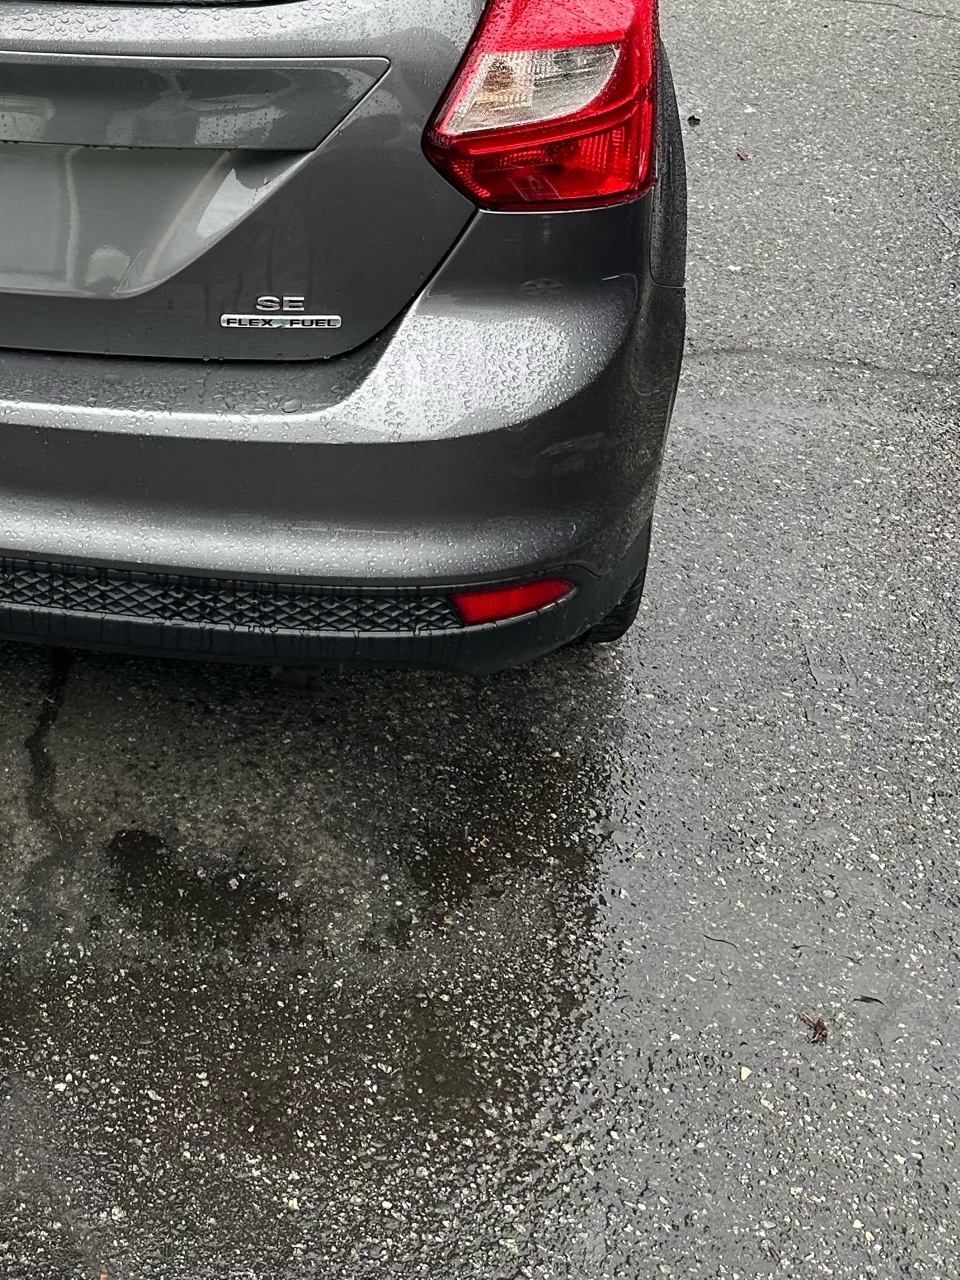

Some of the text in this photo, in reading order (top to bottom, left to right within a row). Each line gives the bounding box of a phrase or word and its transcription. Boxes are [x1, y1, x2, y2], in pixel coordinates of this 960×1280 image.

[255, 296, 305, 311] SE
[226, 318, 337, 327] FLEX FUEL
